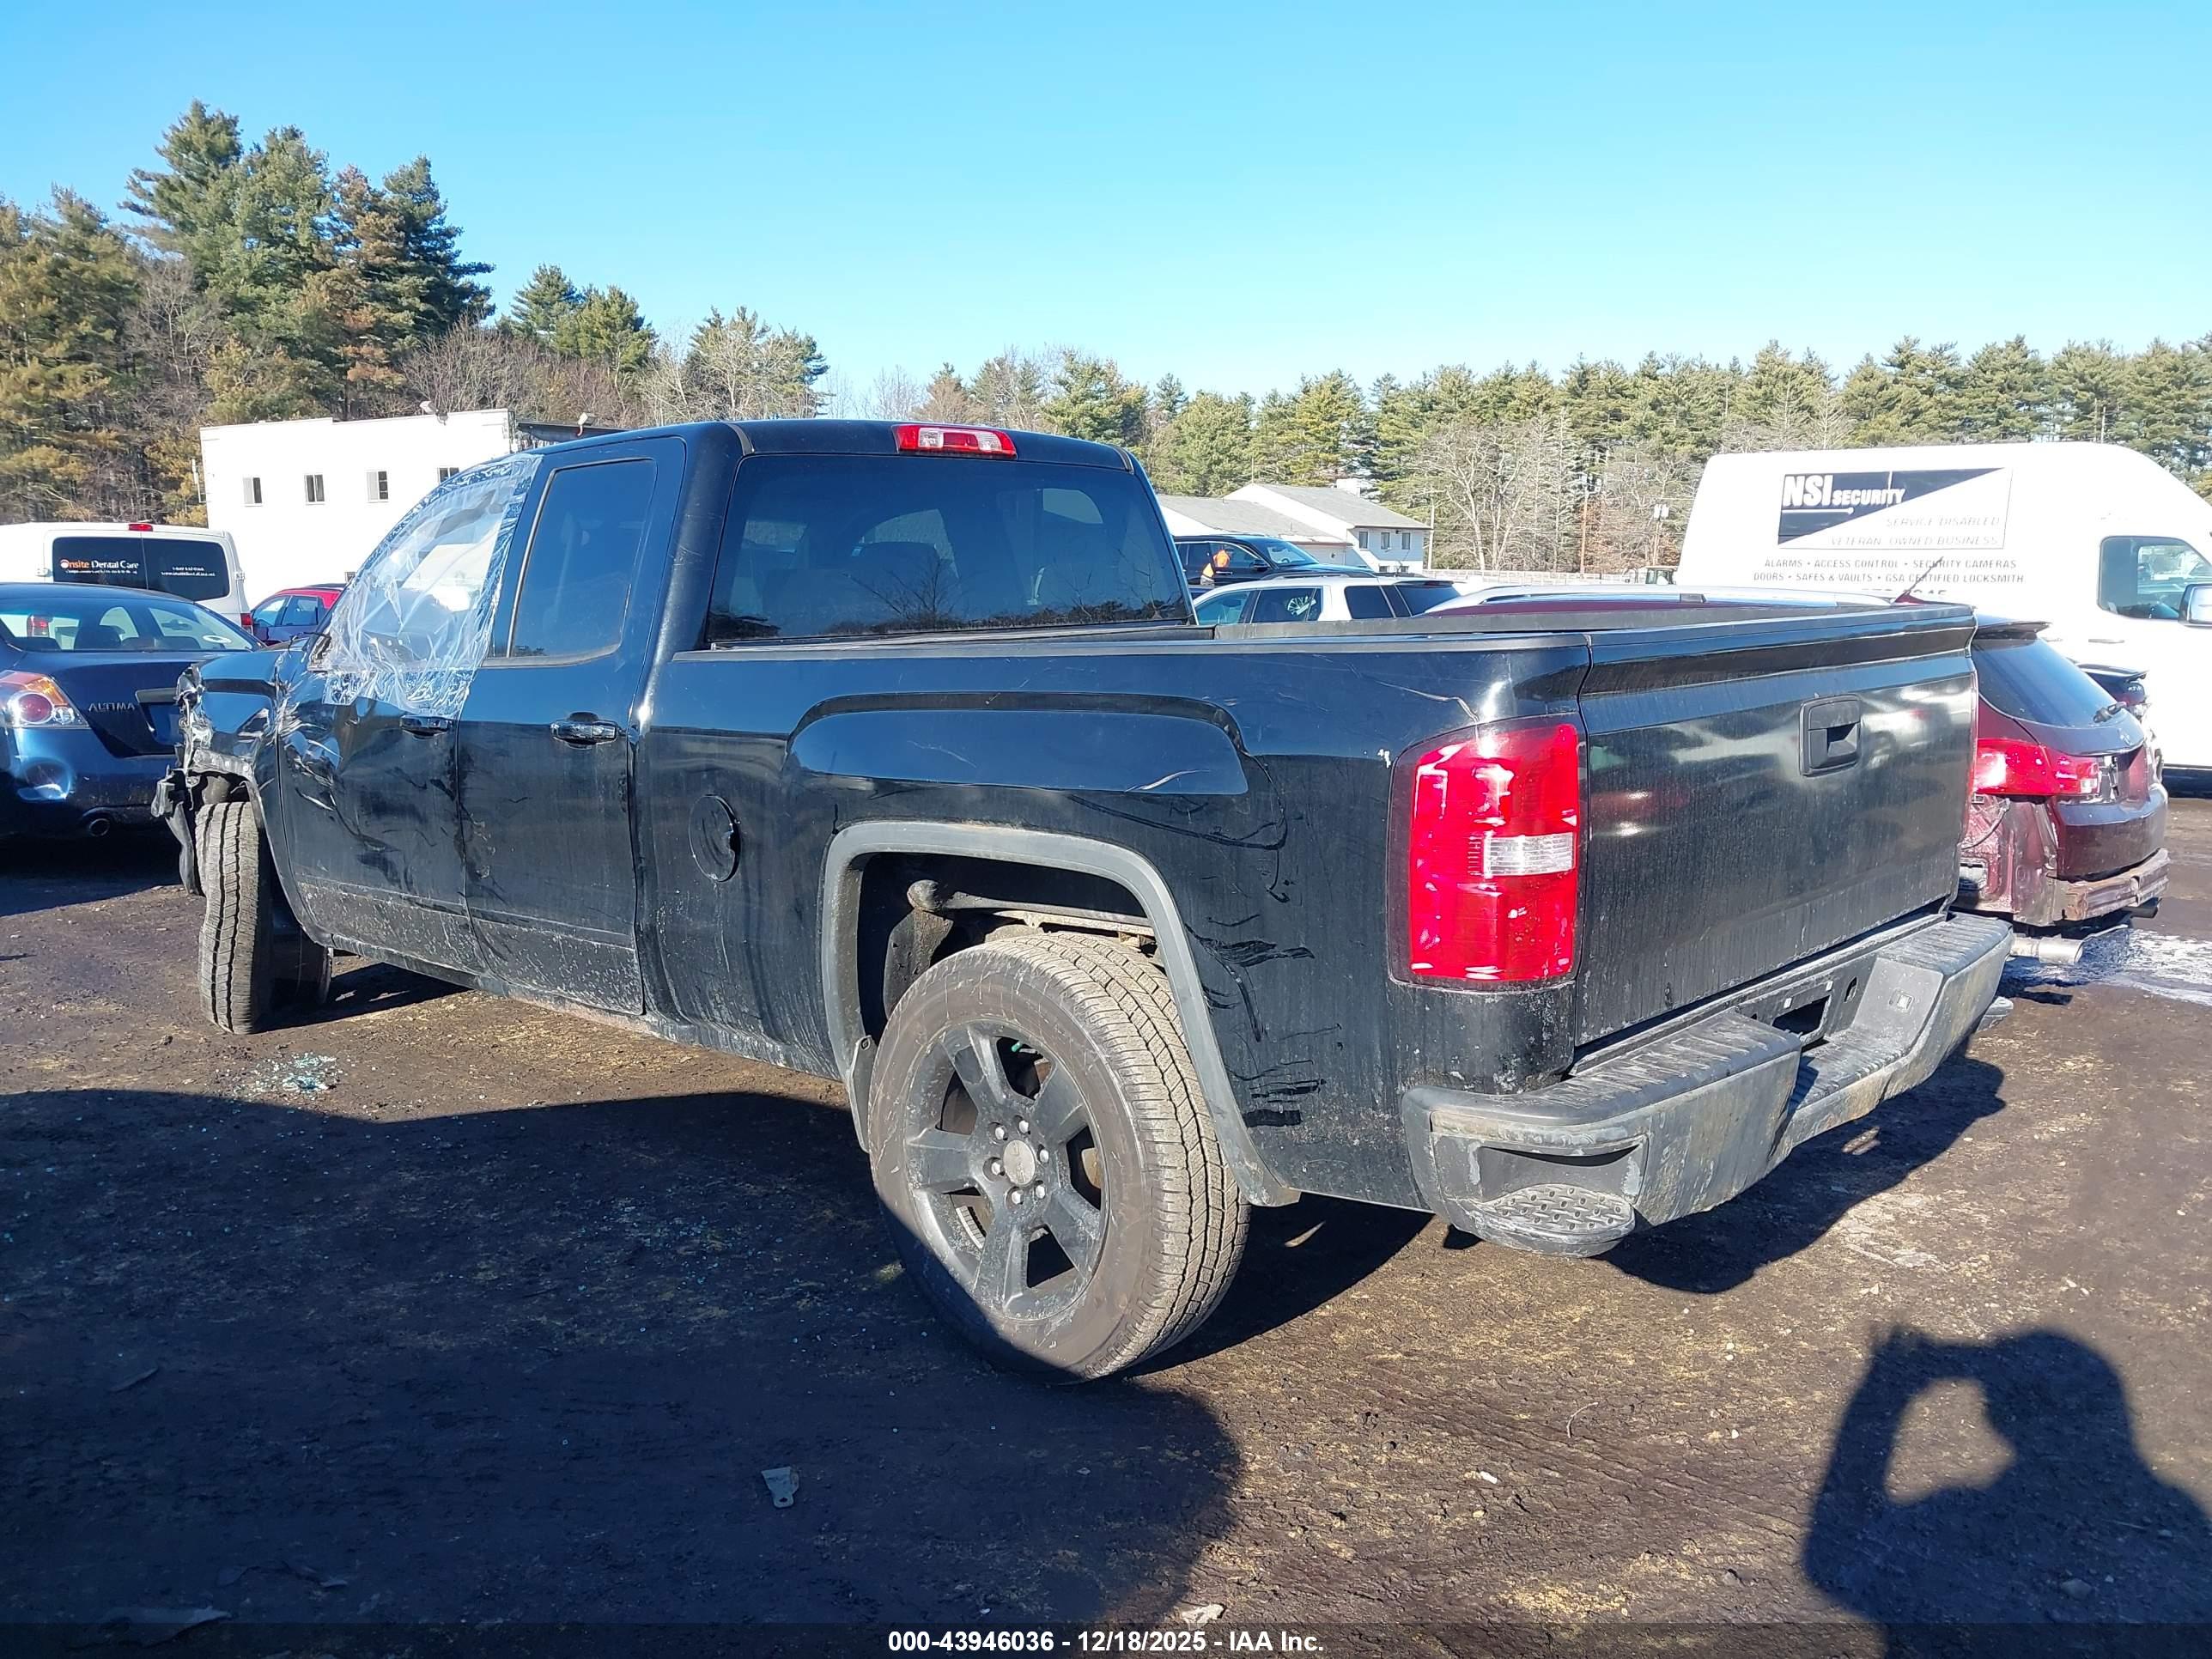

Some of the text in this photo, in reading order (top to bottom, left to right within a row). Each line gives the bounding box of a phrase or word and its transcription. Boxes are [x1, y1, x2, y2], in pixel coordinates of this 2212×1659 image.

[1782, 474, 1833, 507] NSI
[1832, 489, 1905, 506] SECURITY
[1887, 517, 1999, 527] SERVICE DISABLED
[1832, 536, 1997, 545] VETERAN OWNED BUSINESS
[60, 559, 139, 568] Onsite Dental Care
[1765, 559, 1802, 568] ALARMS
[1814, 559, 1850, 568] ACCESS
[1854, 559, 1899, 568] CONTROL
[1965, 560, 2017, 568] CAMERAS
[1753, 573, 1784, 581] DOORS
[1796, 573, 1826, 581] SAFES
[1838, 573, 1873, 582] VAULTS
[1885, 574, 1905, 583] GSA
[1963, 574, 2024, 583] LOCKSMITH
[88, 702, 136, 712] ALTIMA
